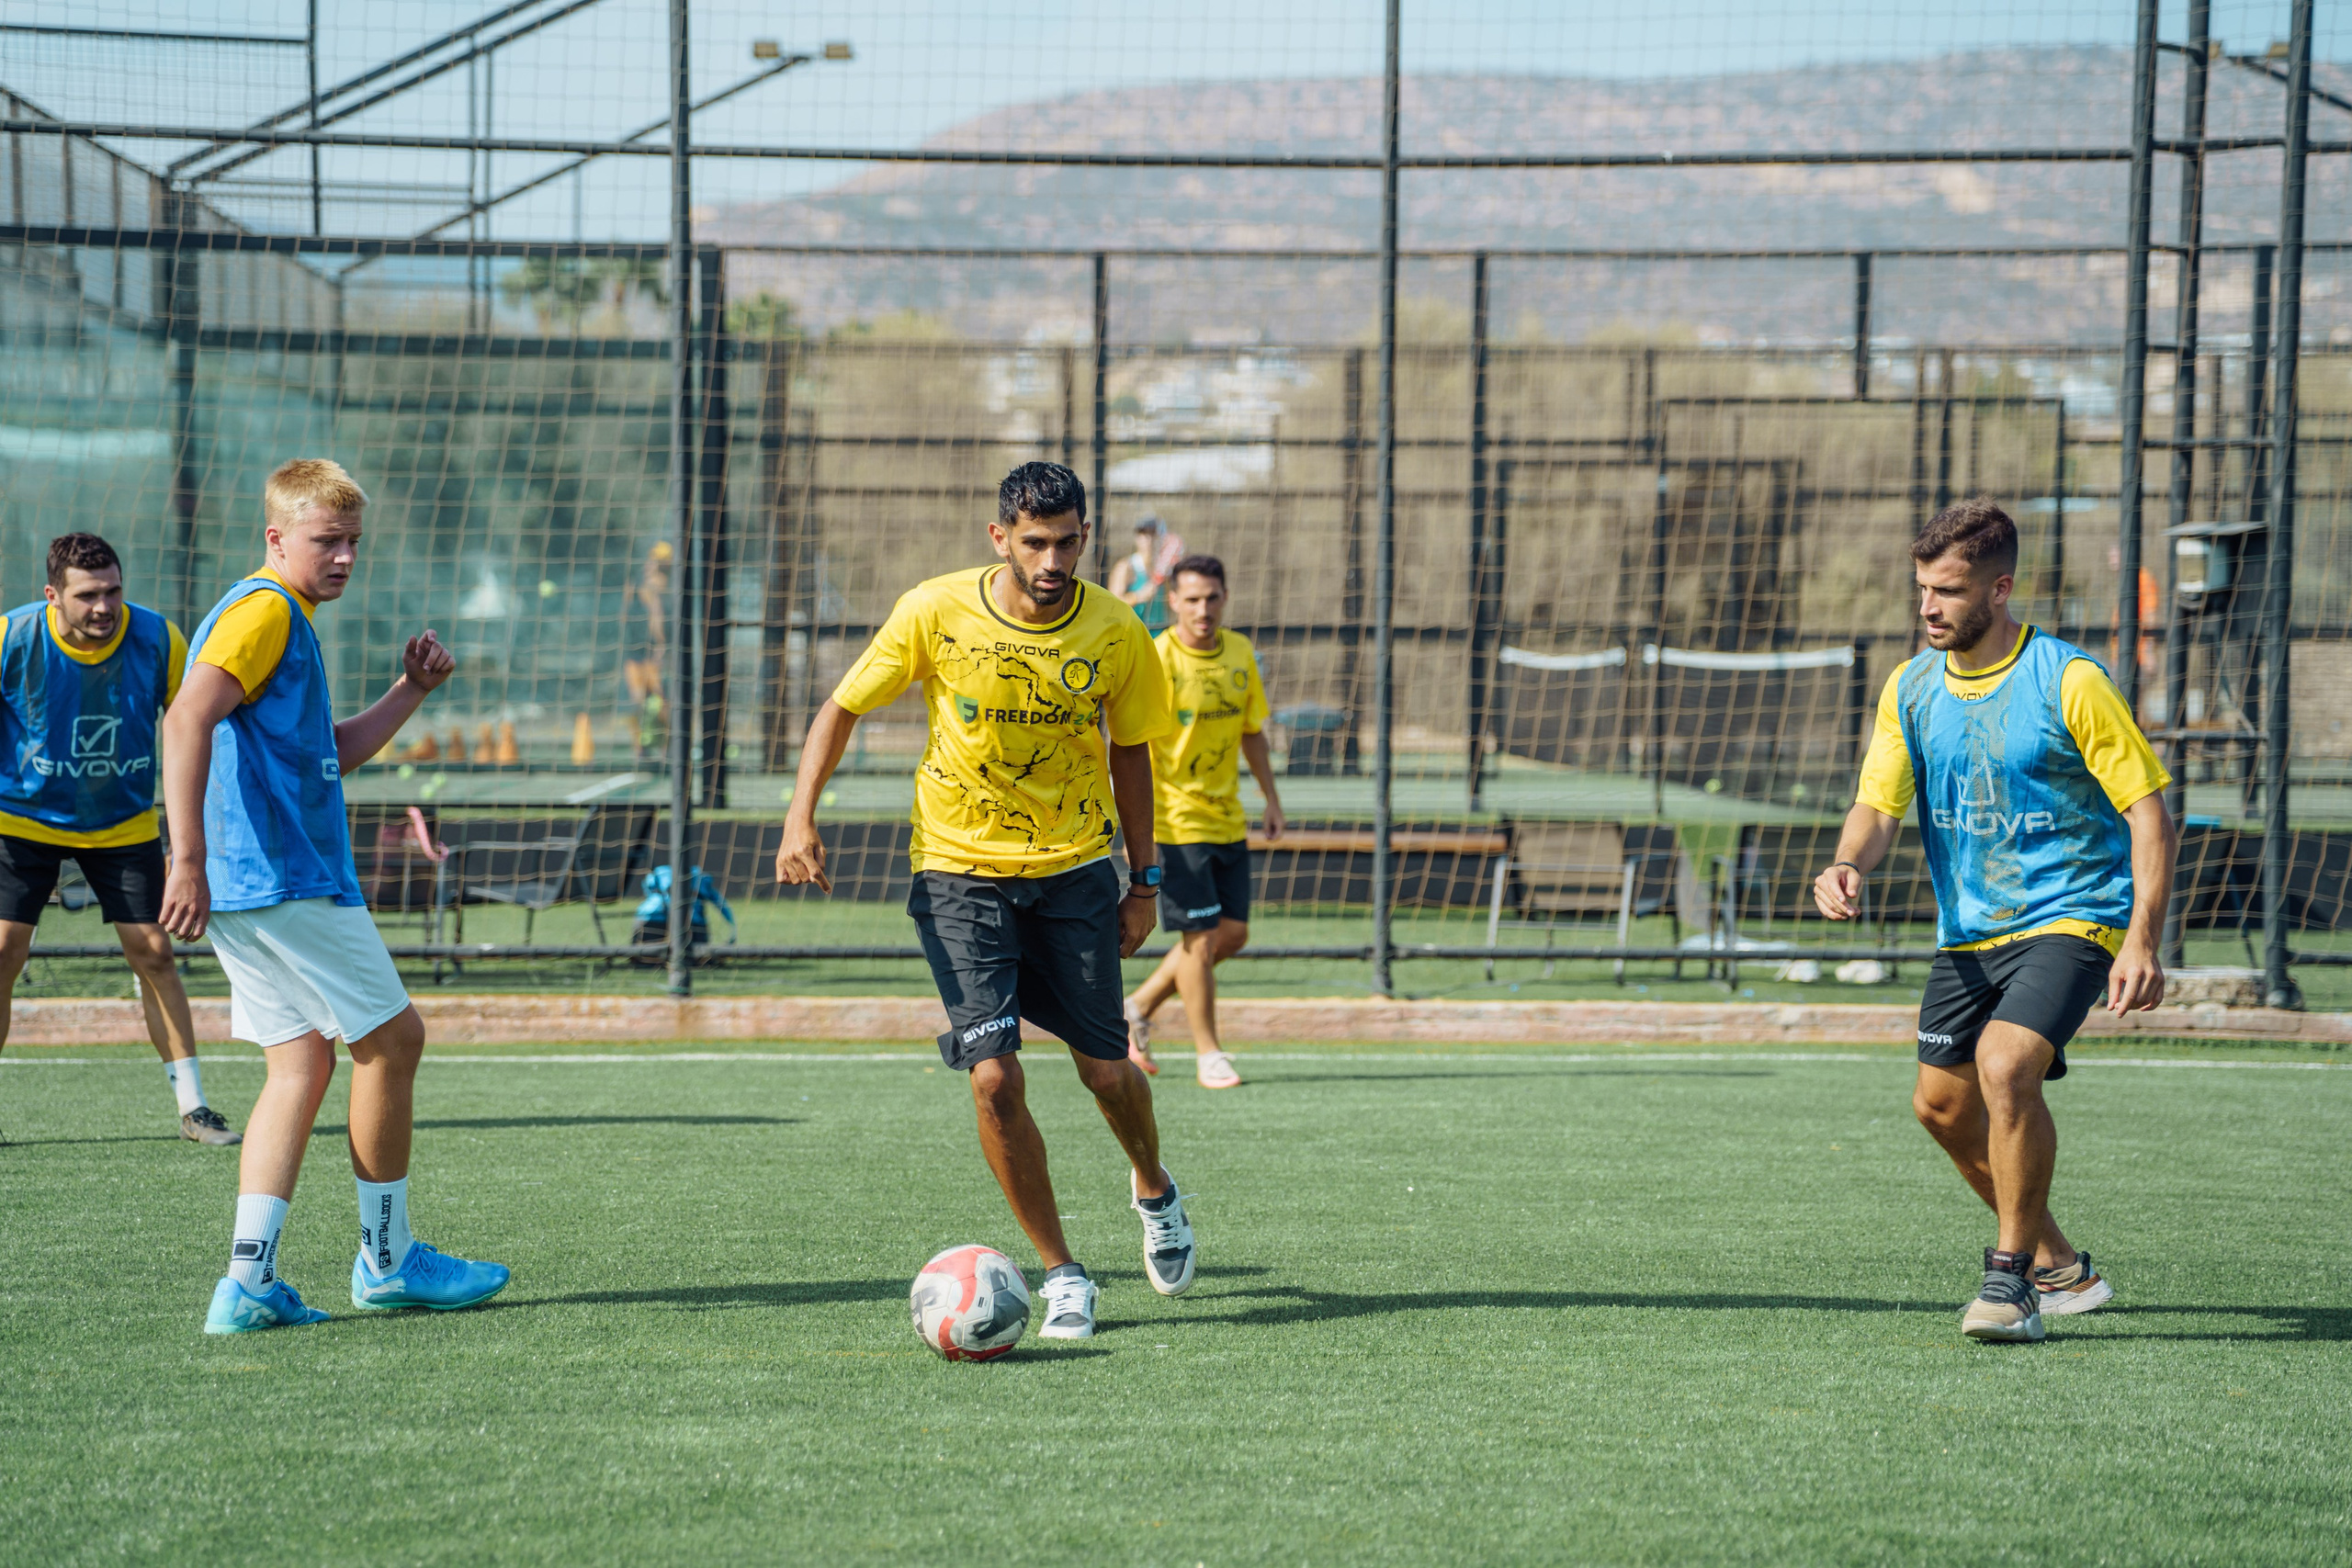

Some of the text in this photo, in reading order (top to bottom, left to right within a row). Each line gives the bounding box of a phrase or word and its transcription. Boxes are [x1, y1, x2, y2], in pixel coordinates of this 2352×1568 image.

[995, 642, 1060, 659] GIVOVA
[985, 708, 1071, 725] FREEDOM
[32, 756, 150, 778] GIVOVA
[963, 1016, 1016, 1043] GIVOVA
[379, 1253, 390, 1268] FS
